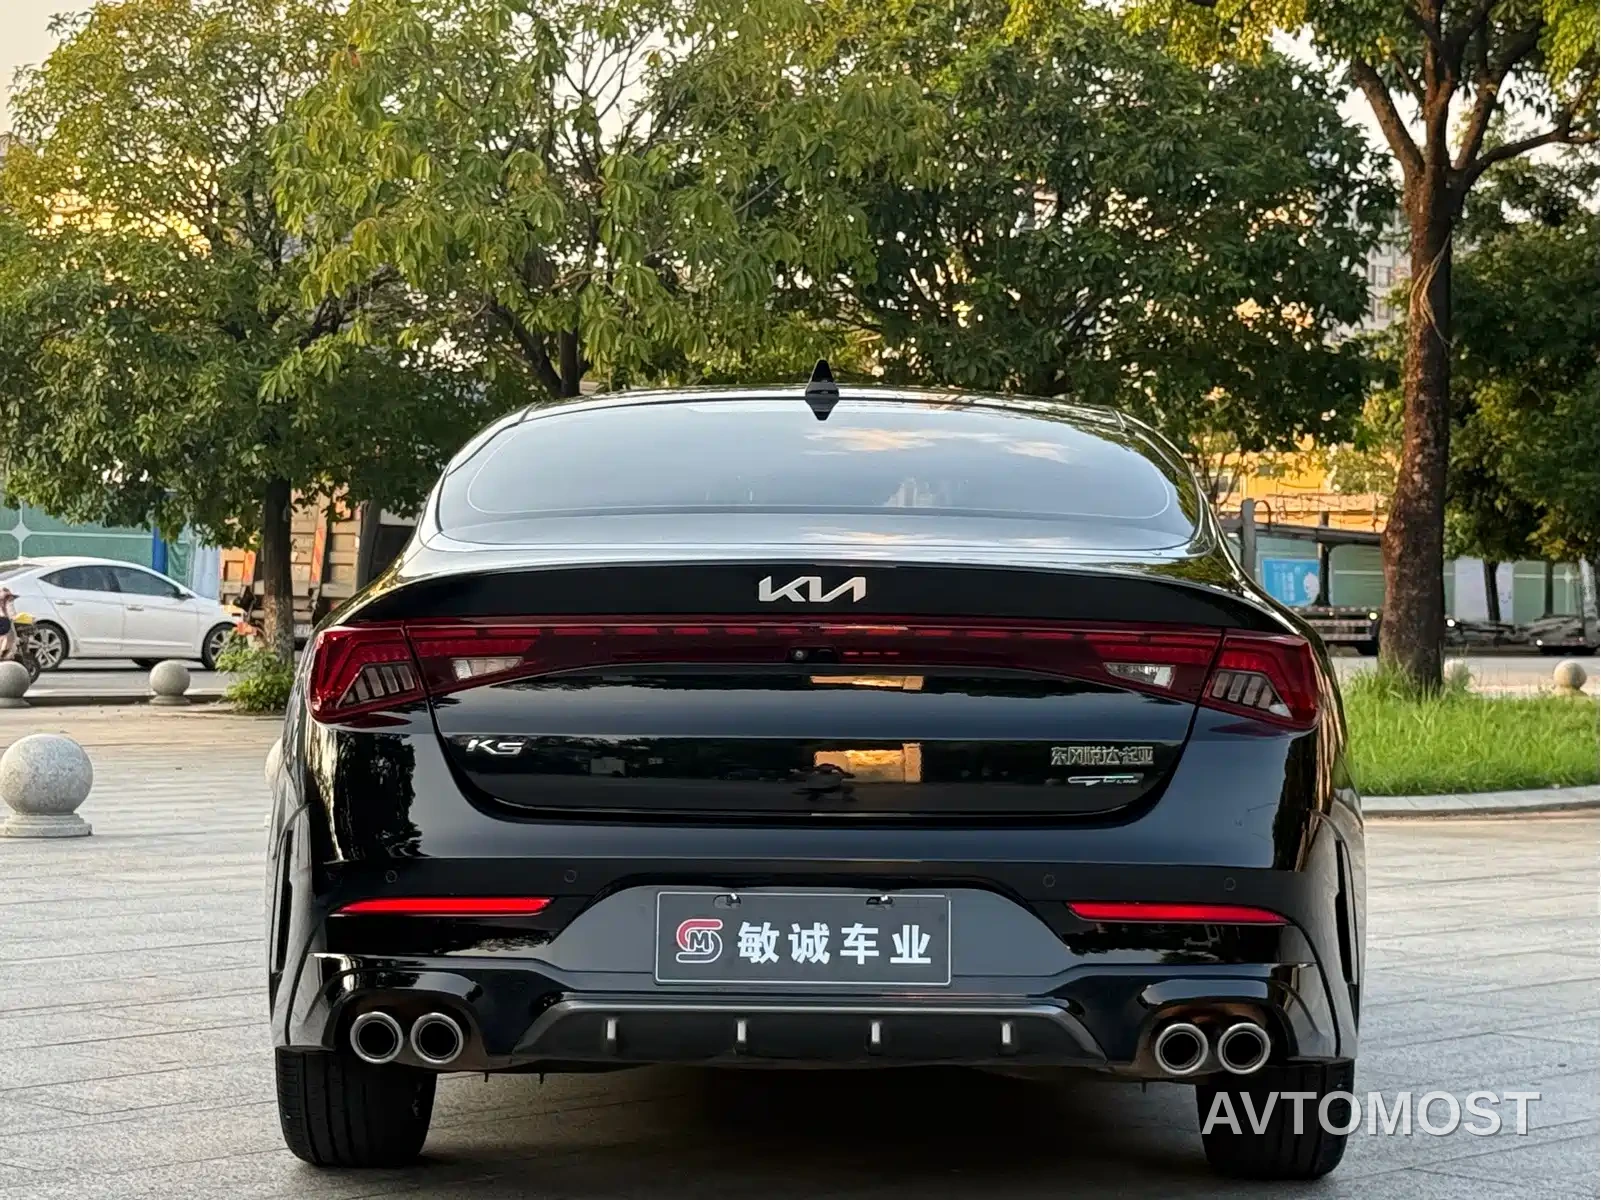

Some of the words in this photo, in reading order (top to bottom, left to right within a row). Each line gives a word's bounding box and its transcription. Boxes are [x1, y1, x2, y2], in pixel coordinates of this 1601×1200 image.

[758, 576, 867, 603] KIA
[466, 739, 525, 755] K5
[737, 921, 932, 965] 敏诚车业
